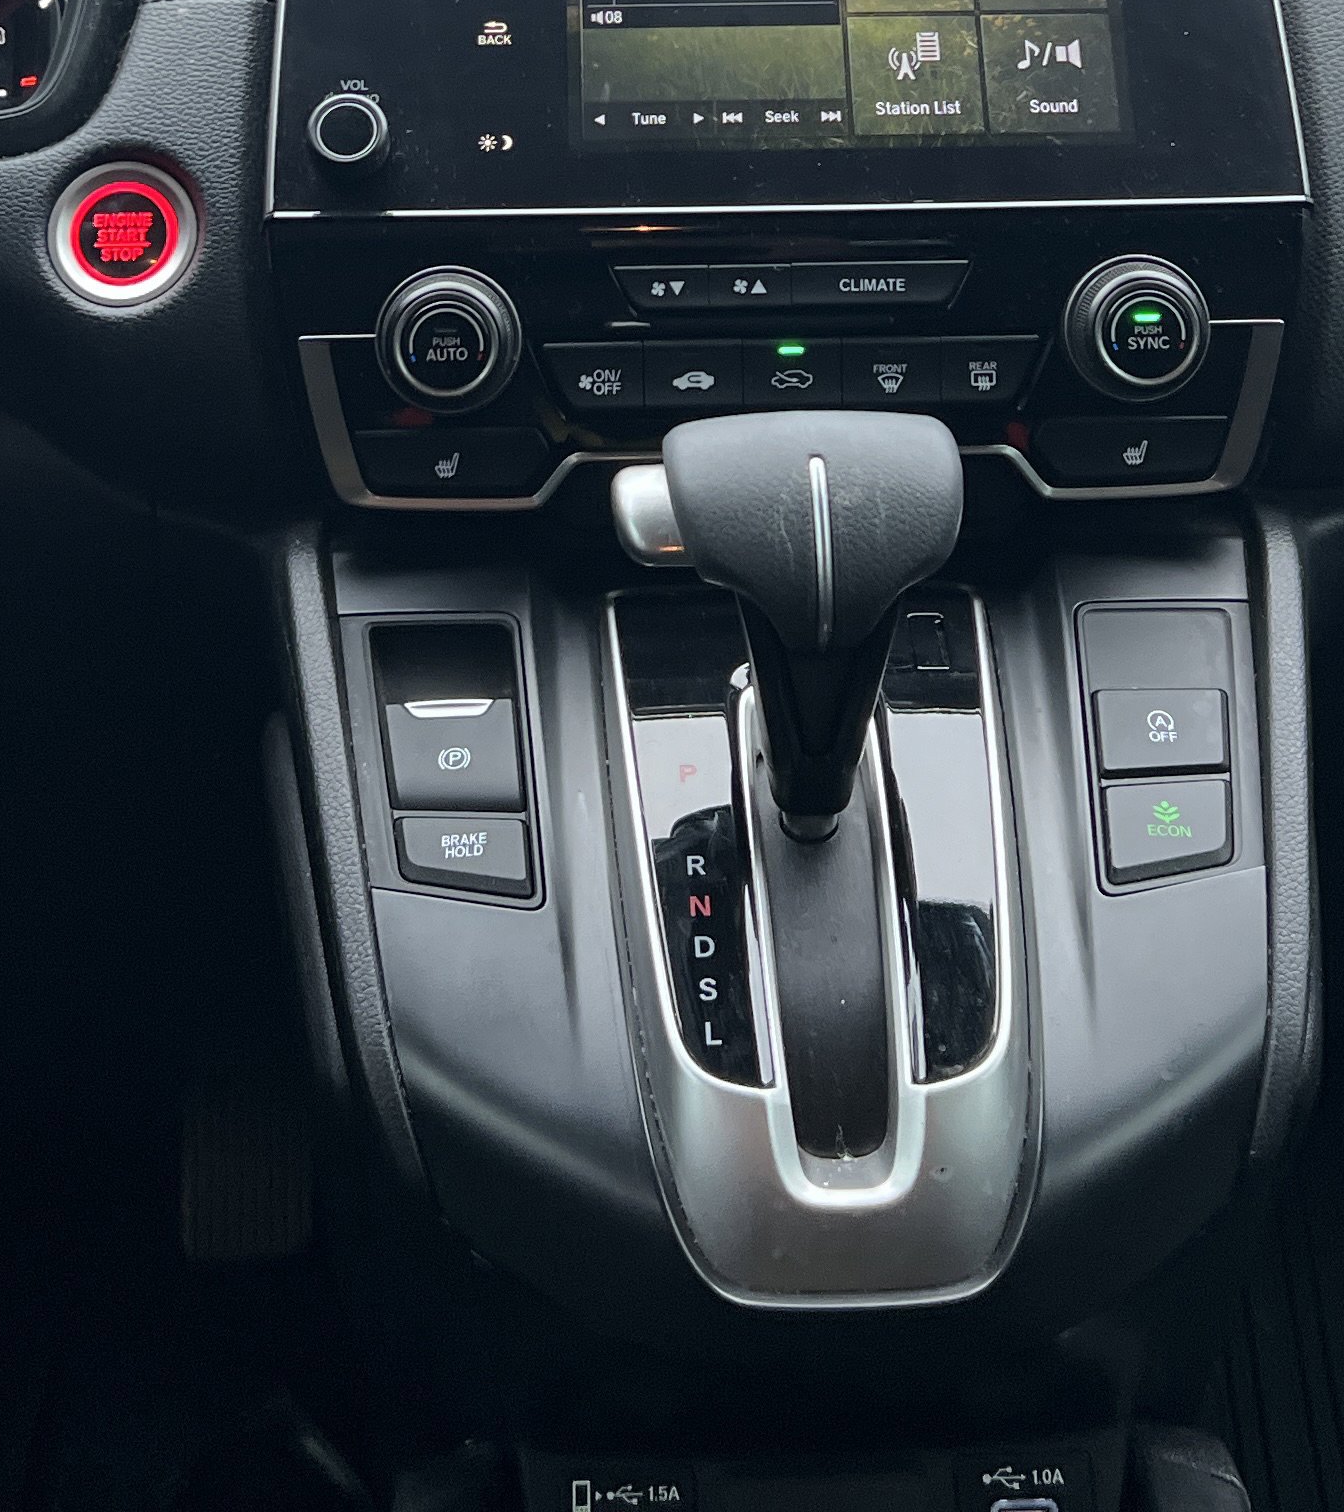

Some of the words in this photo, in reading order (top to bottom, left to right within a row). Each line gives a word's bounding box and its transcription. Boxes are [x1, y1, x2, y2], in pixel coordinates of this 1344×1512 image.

[605, 10, 623, 24] 08
[477, 34, 513, 46] BACK
[340, 78, 369, 92] VOL
[875, 100, 931, 116] Station
[933, 99, 962, 115] List
[1029, 98, 1079, 114] Sound
[631, 111, 667, 126] Tune
[764, 109, 800, 124] Seek
[93, 212, 154, 228] ENGINE
[97, 228, 149, 243] START
[100, 247, 144, 262] STOP
[839, 278, 906, 293] CLIMATE
[1134, 324, 1163, 335] PUSH
[432, 336, 461, 347] PUSH
[1127, 336, 1171, 350] SYNC
[425, 348, 469, 362] AUTO
[873, 363, 908, 374] FRONT
[968, 361, 998, 371] REAR
[593, 369, 622, 382] ON/
[593, 382, 622, 396] OFF
[1148, 731, 1178, 743] OFF
[679, 764, 698, 783] P
[1146, 823, 1193, 838] ECON
[441, 831, 488, 847] BRAKE
[444, 844, 484, 859] HOLD
[686, 855, 707, 876] R
[689, 895, 712, 917] N
[694, 935, 716, 958] D
[699, 977, 718, 1002] S
[704, 1021, 723, 1046] L
[1031, 1468, 1065, 1486] 1.0A
[648, 1485, 681, 1502] 1.5A
